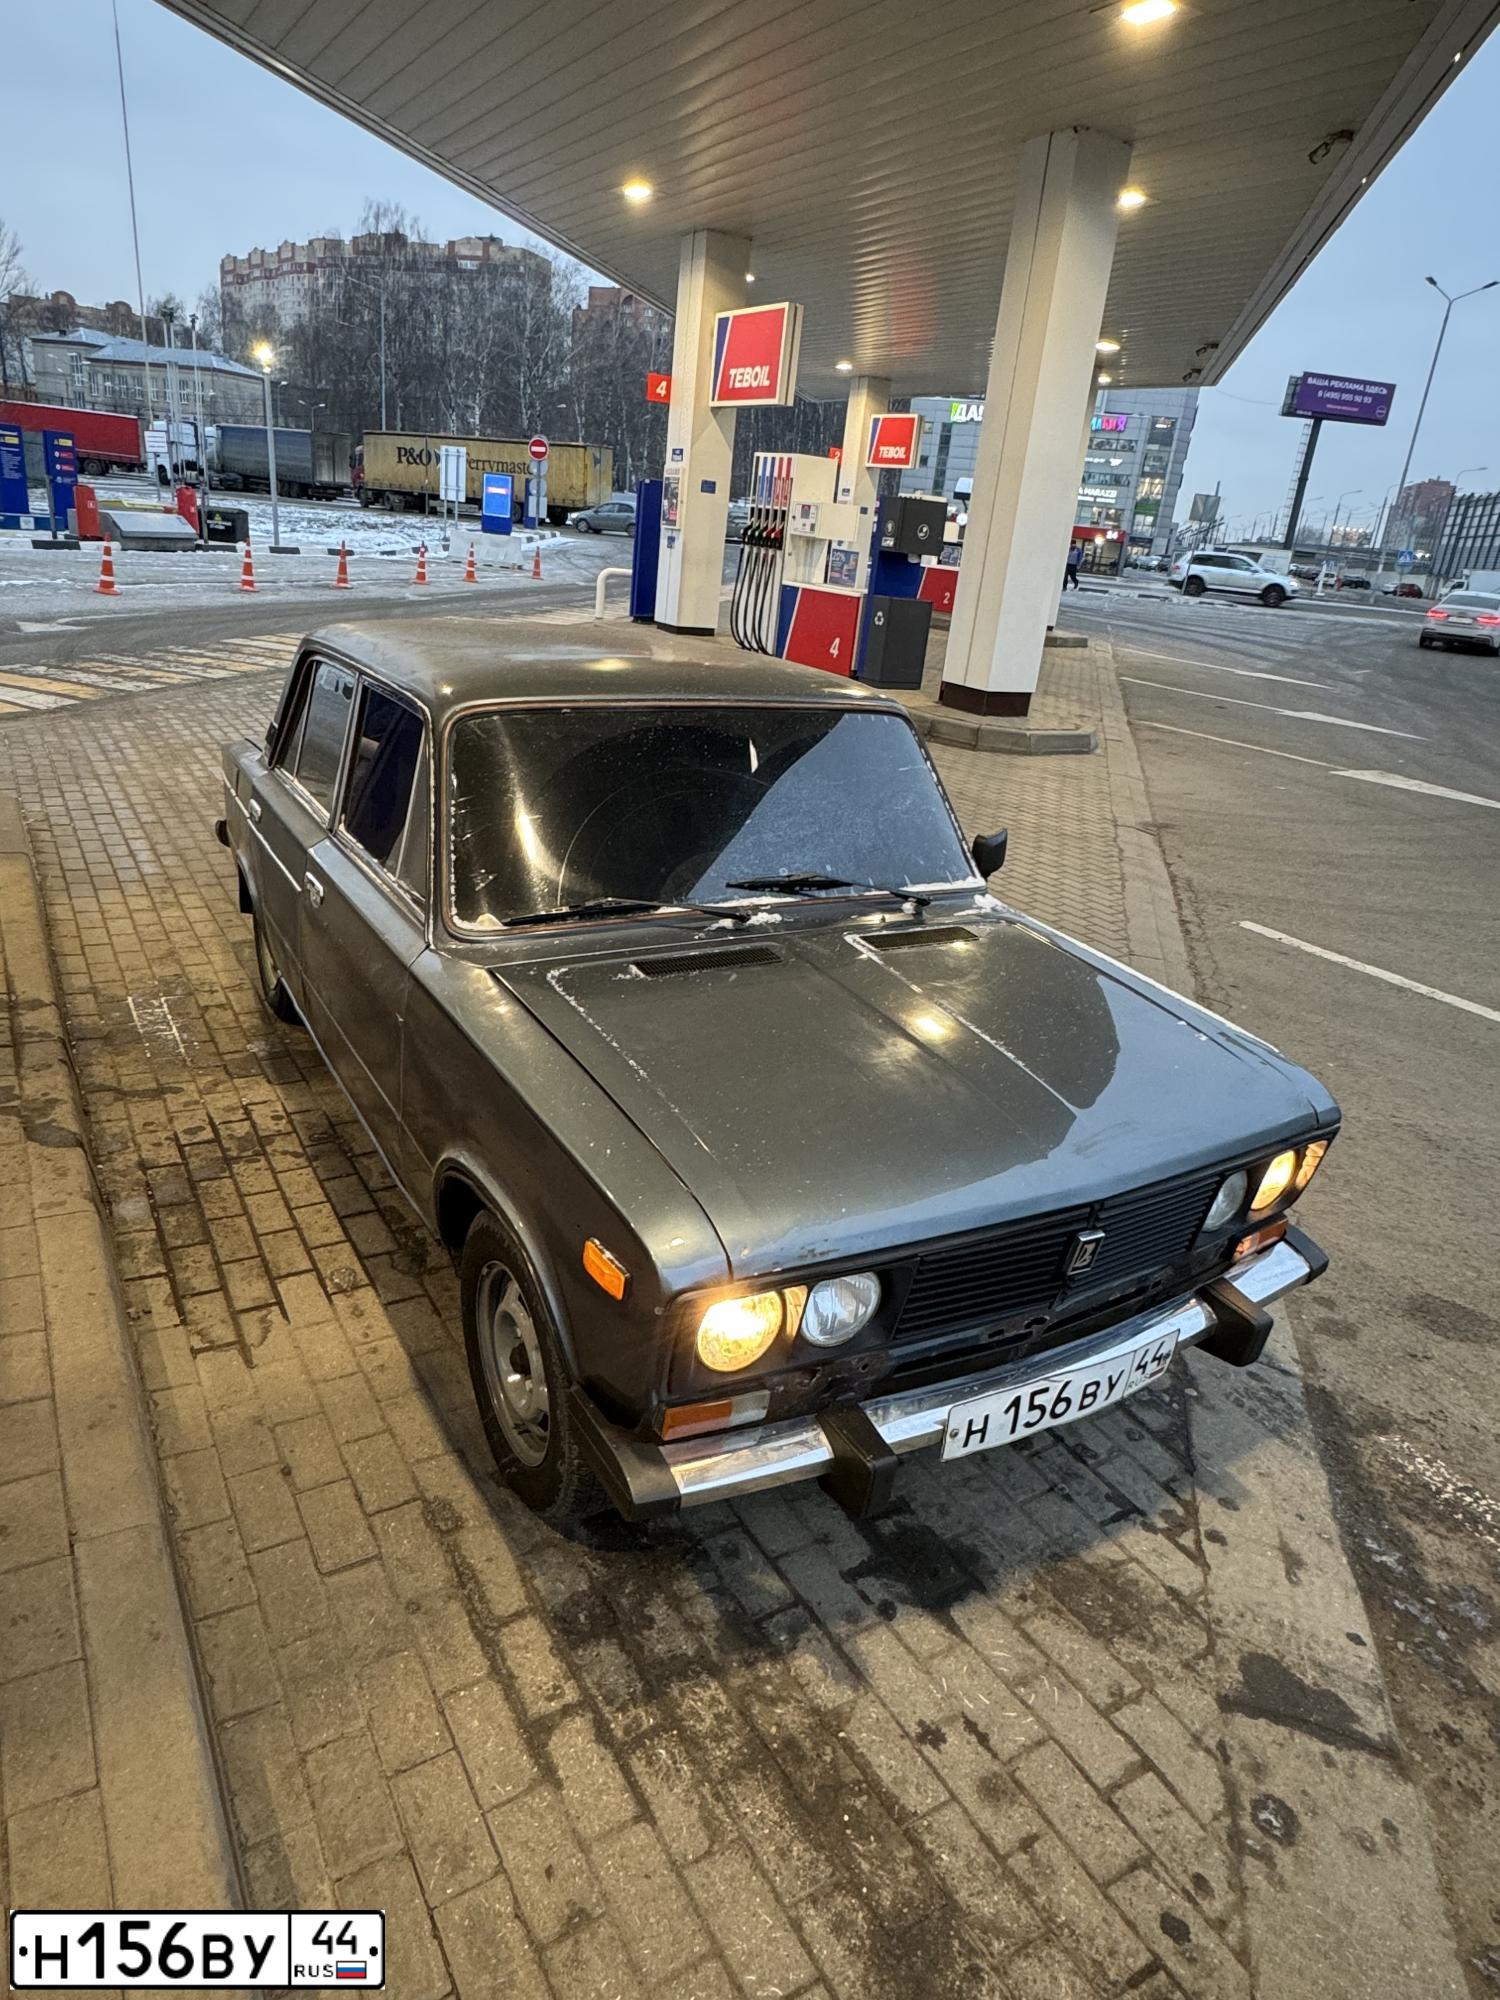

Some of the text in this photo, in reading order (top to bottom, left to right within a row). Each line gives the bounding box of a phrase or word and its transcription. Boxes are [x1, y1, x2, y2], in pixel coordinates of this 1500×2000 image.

[729, 366, 771, 389] TEBOIL
[1307, 377, 1388, 394] ВАША РЕКЛАМА ЗДЕСЬ
[656, 381, 667, 397] 4
[951, 403, 984, 422] ДА!
[396, 447, 432, 466] P&O
[879, 446, 907, 459] TEBOIL
[943, 592, 951, 604] 2
[829, 637, 841, 658] 4
[1135, 1340, 1165, 1375] 44
